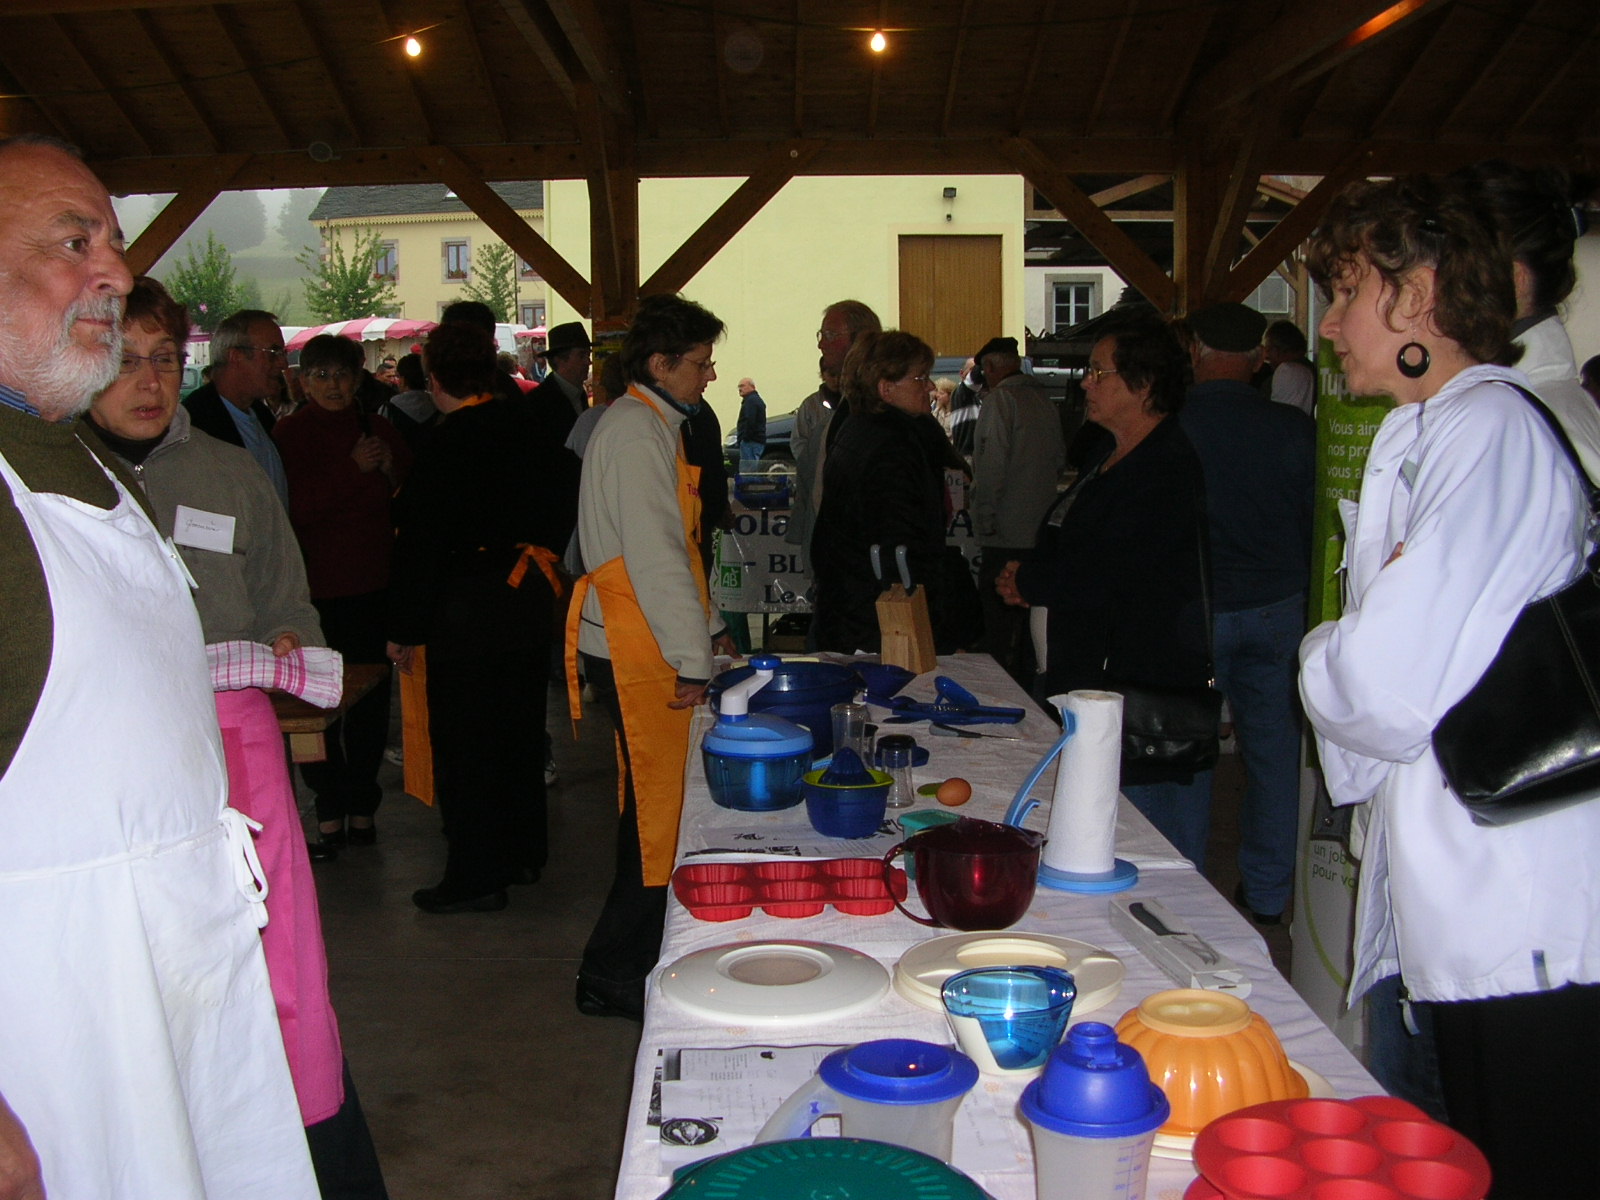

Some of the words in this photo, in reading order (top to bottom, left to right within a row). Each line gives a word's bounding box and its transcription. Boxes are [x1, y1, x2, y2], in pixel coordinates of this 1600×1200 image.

[1320, 368, 1355, 401] Tup
[1329, 419, 1353, 434] Vous
[1328, 444, 1345, 456] nos
[1327, 466, 1350, 478] vous
[1326, 488, 1343, 499] nos
[722, 509, 791, 537] ola
[722, 572, 738, 587] AB
[1313, 844, 1326, 857] un
[1329, 847, 1347, 864] job
[1312, 864, 1337, 881] pour
